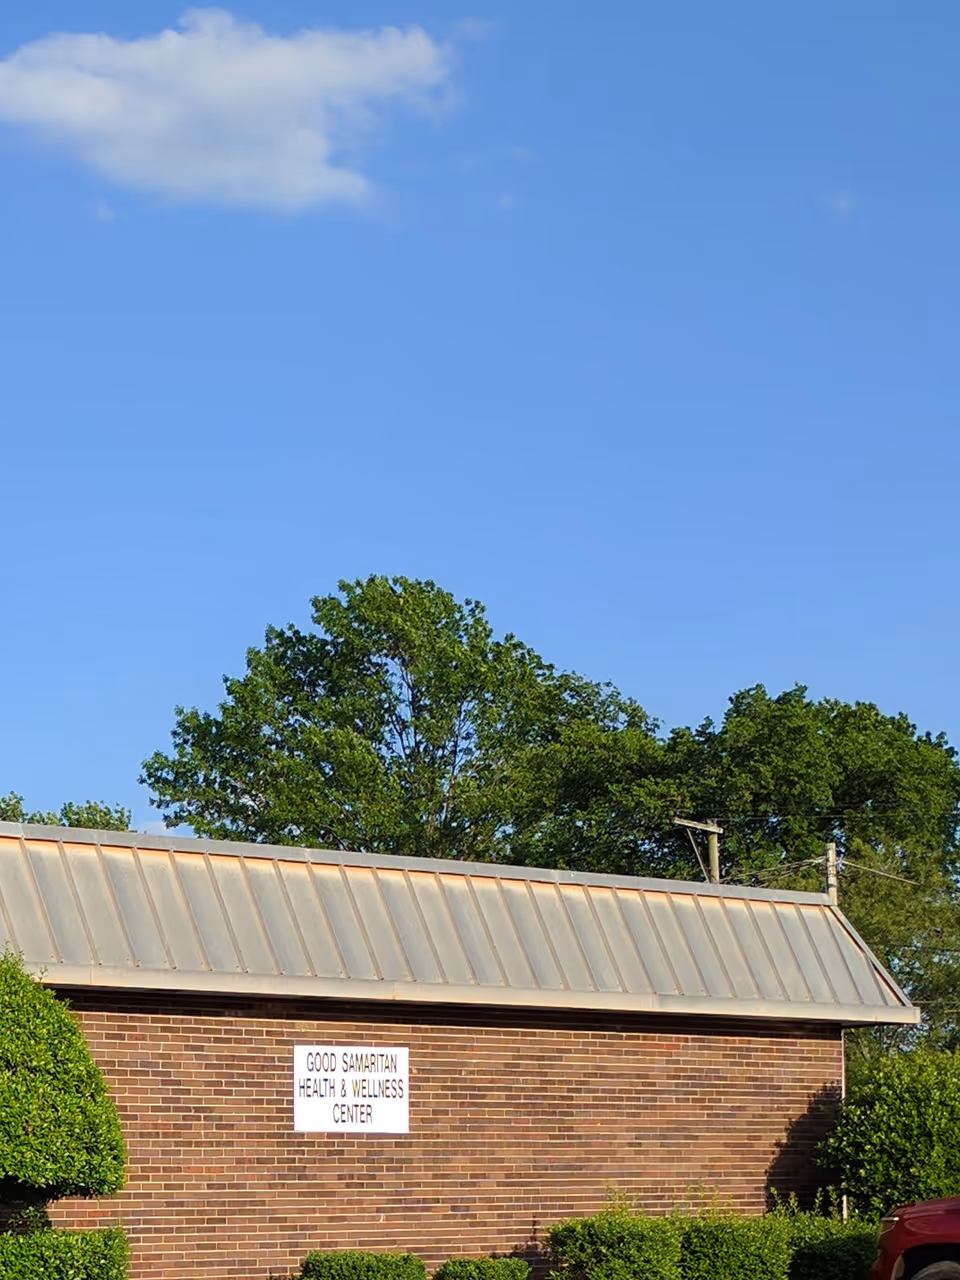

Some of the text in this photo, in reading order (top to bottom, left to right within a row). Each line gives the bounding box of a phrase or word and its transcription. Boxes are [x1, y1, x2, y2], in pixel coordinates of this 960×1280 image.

[306, 1052, 397, 1073] GOOD SAMARITAN
[299, 1078, 404, 1098] HEALTH & WELLNESS
[333, 1103, 373, 1124] CENTER
